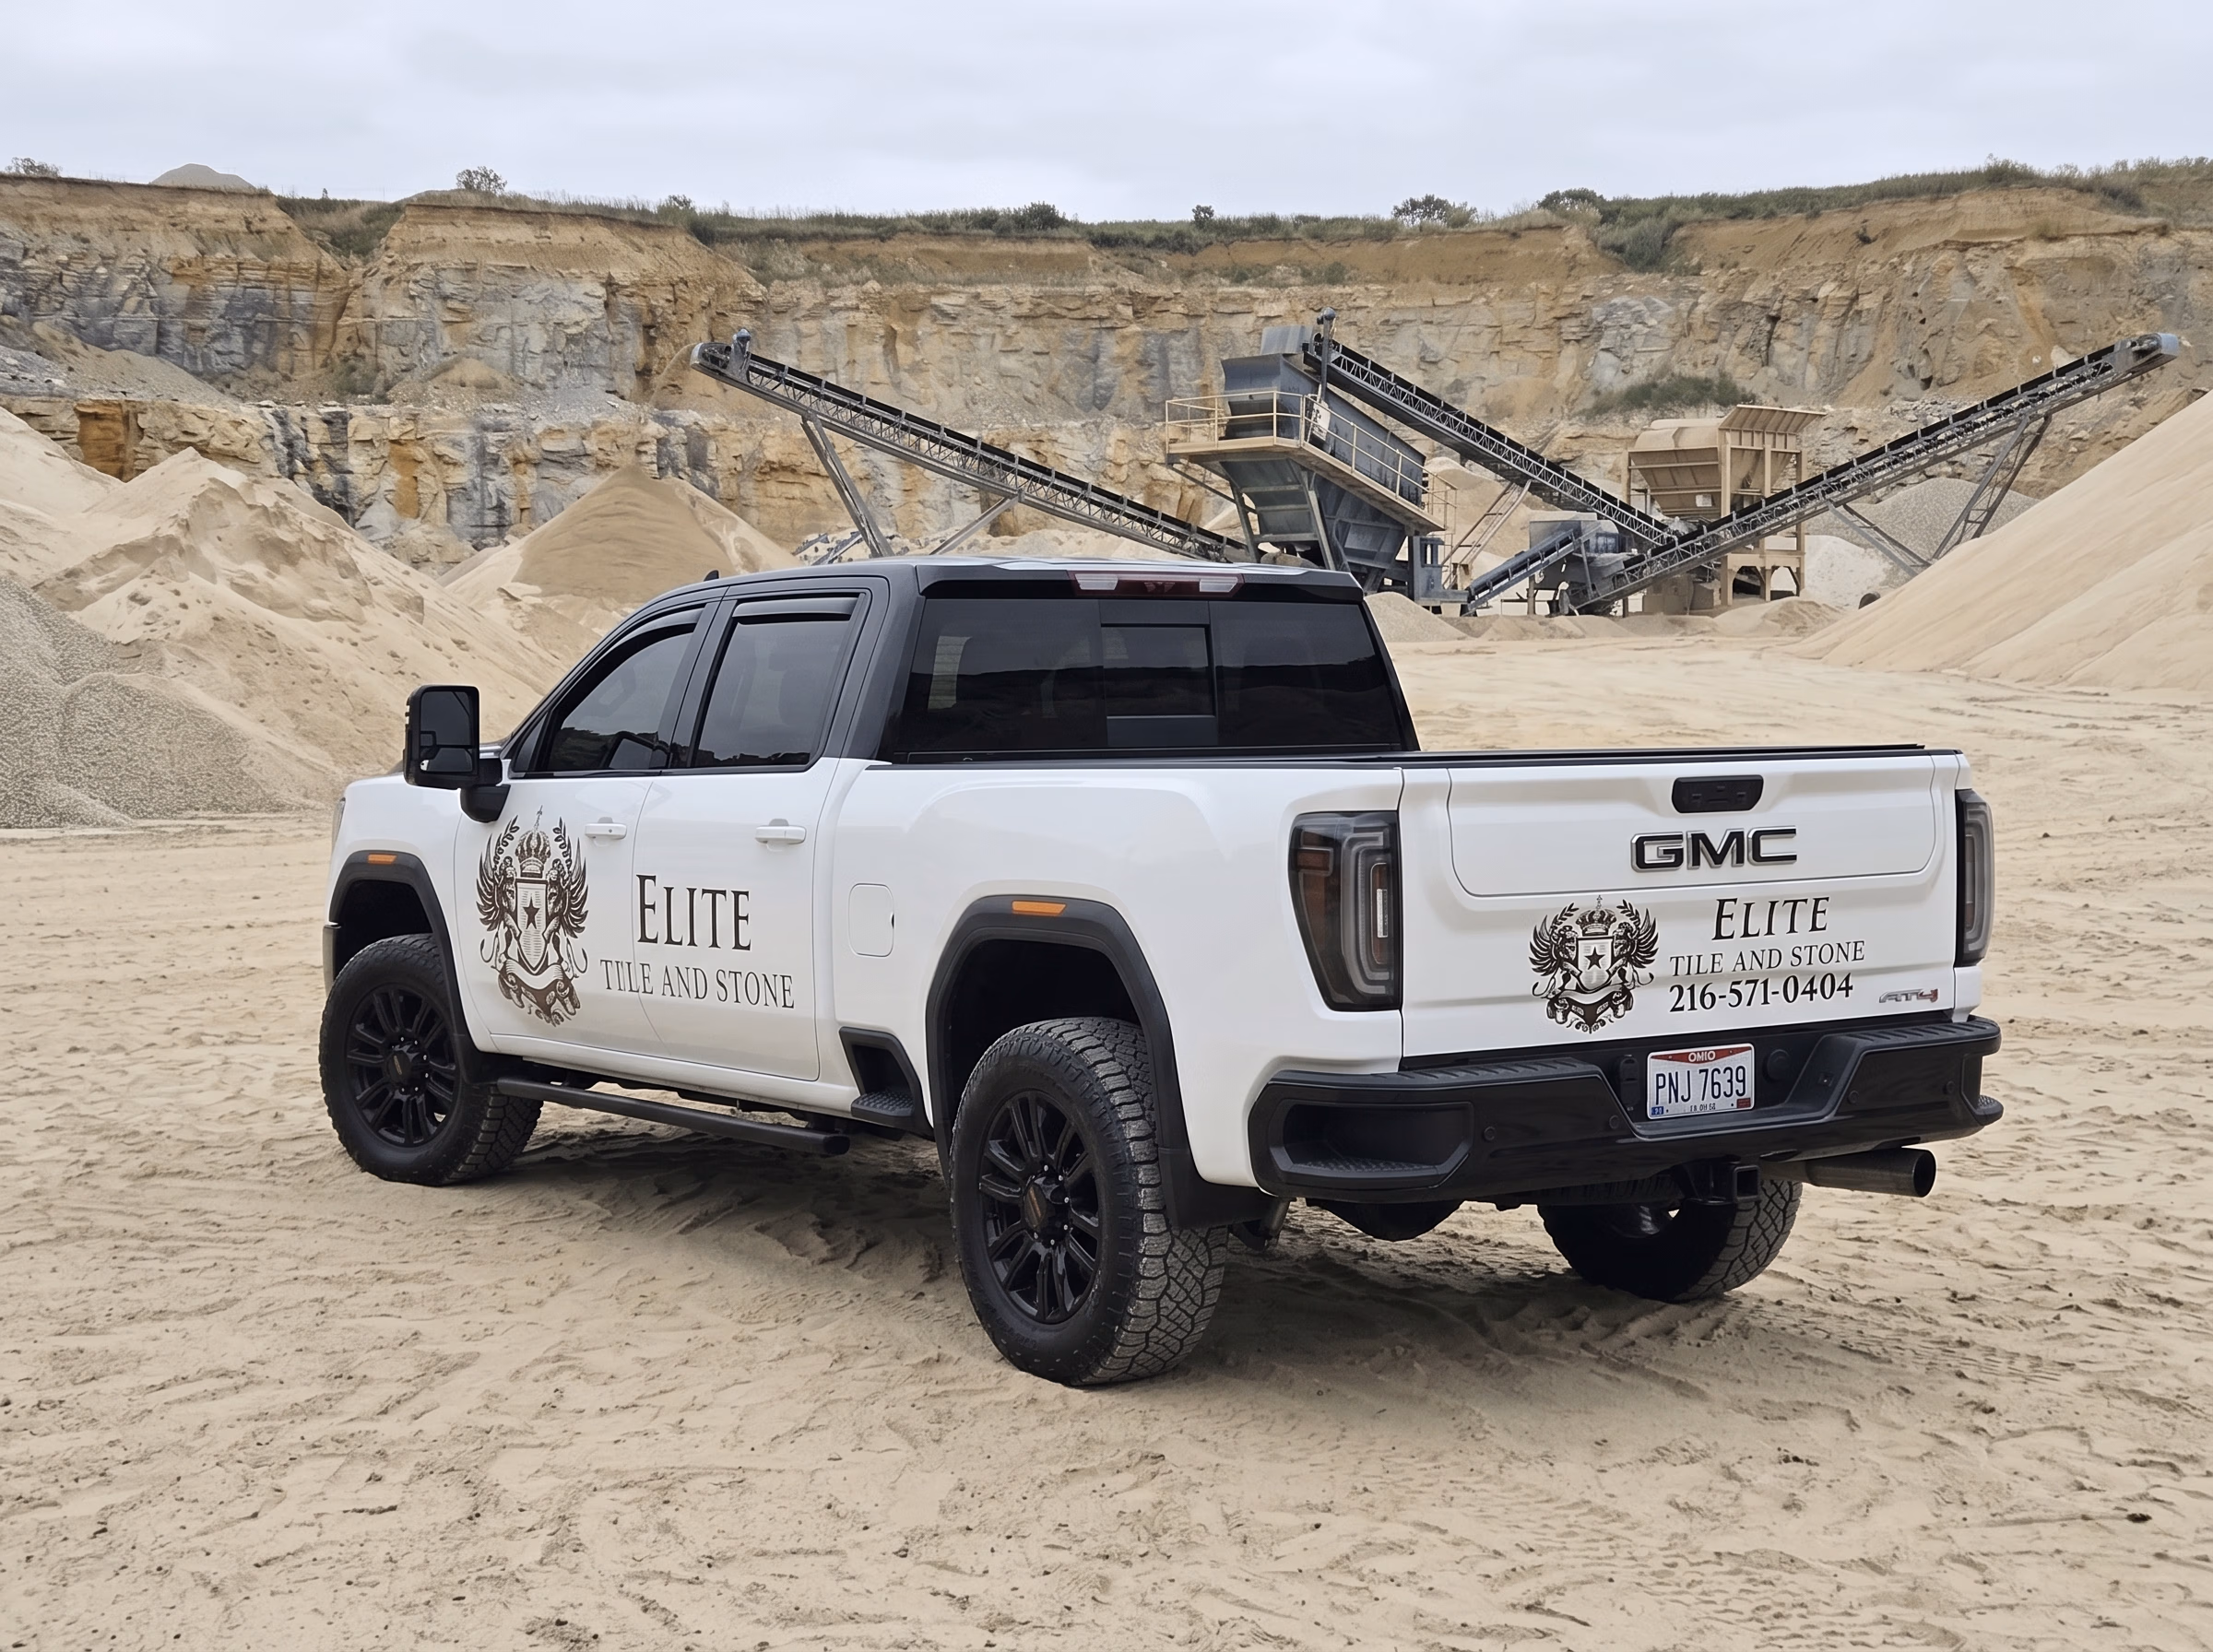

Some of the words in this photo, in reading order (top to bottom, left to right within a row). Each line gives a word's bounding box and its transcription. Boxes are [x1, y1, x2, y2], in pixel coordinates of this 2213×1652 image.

[1630, 825, 1797, 873] GMC
[636, 874, 751, 951] ELITE
[1711, 896, 1830, 940] ELITE
[1669, 952, 1723, 977] TILE
[1732, 948, 1782, 972] AND
[1791, 940, 1865, 966] STONE
[599, 959, 654, 995] TILE
[661, 964, 708, 1000] AND
[716, 969, 795, 1009] STONE
[1669, 974, 1854, 1012] 216-571-0404
[1878, 988, 1939, 1004] AT4
[1655, 1070, 1691, 1105] PNJ
[1698, 1065, 1746, 1102] 7639
